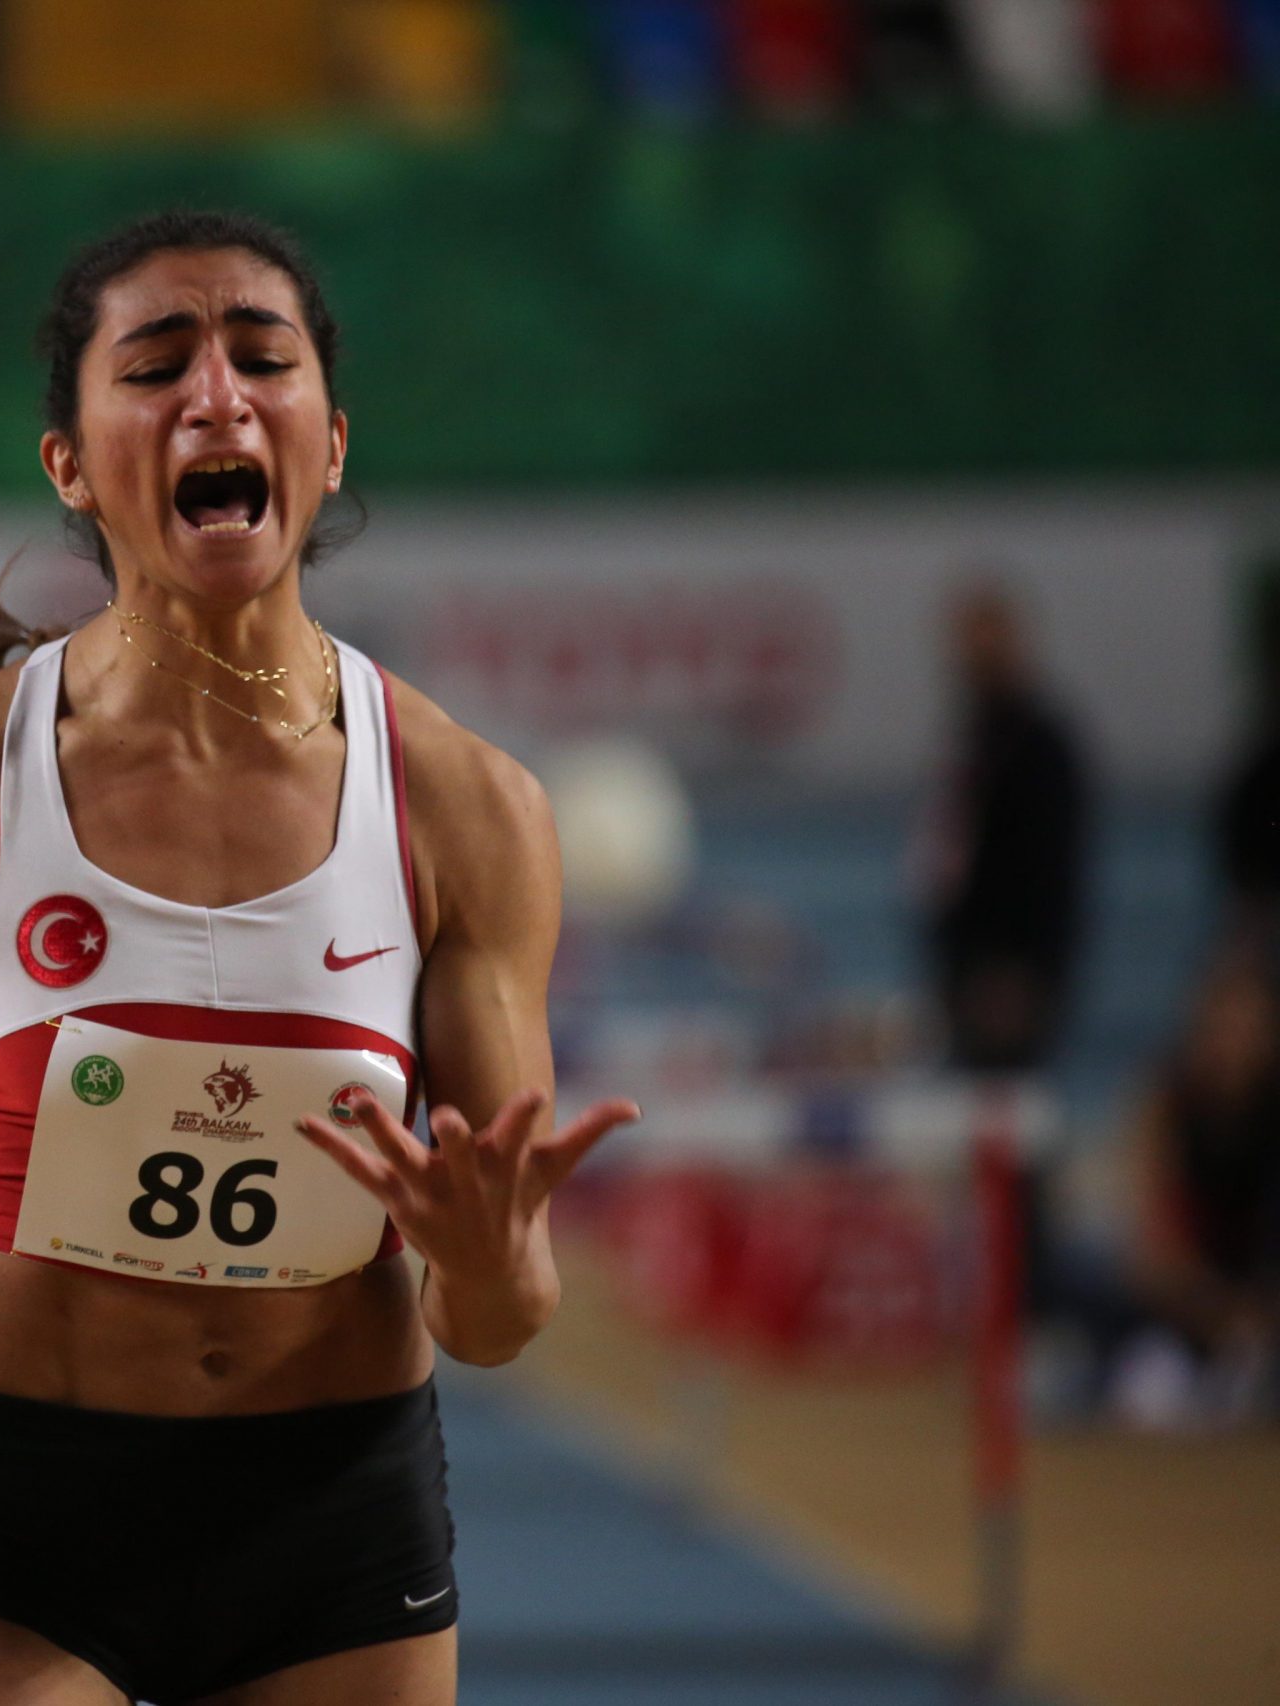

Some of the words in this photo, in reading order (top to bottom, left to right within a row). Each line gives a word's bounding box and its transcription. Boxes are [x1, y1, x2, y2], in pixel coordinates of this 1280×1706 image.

[173, 1116, 198, 1127] 24th
[201, 1118, 252, 1130] BALKAN
[129, 1151, 278, 1247] 86
[65, 1243, 105, 1258] TURKCELL
